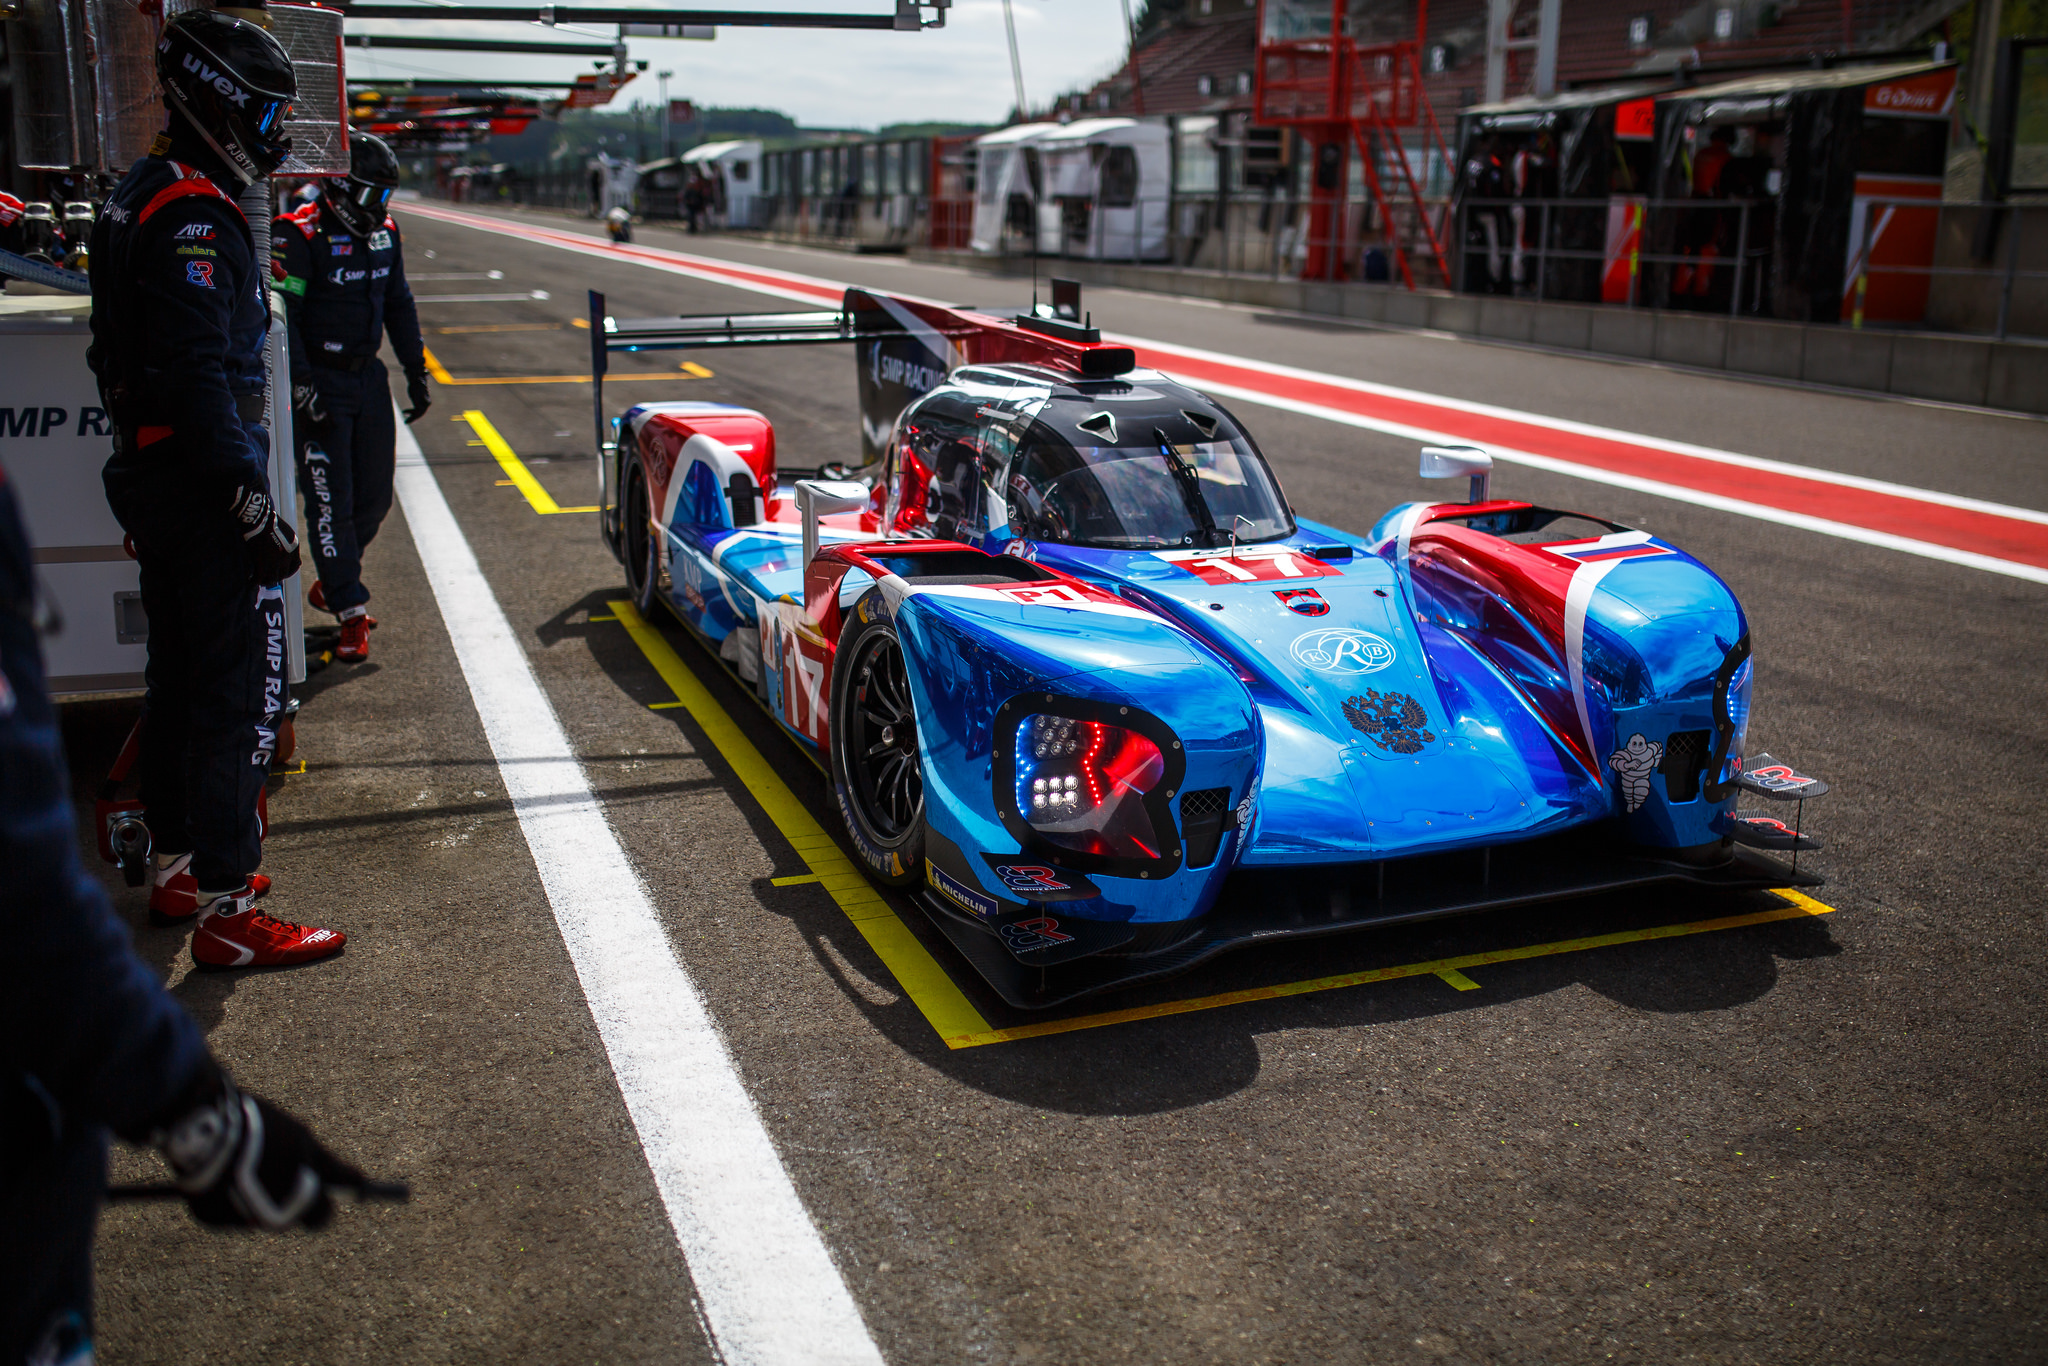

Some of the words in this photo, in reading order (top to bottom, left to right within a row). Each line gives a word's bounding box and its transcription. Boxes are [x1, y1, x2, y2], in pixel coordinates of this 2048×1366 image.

[182, 52, 252, 109] uvex
[225, 143, 255, 170] #JB17
[177, 224, 213, 236] ART
[176, 245, 217, 257] dallara
[881, 355, 904, 385] SMP
[904, 361, 946, 393] RACING
[311, 466, 331, 503] SMP
[241, 493, 263, 523] OMP
[1192, 553, 1304, 581] 17
[1009, 589, 1075, 602] P1
[265, 611, 283, 672] SMP
[785, 646, 825, 739] 17
[837, 793, 882, 871] MICHELIN
[942, 881, 987, 915] MICHELIN
